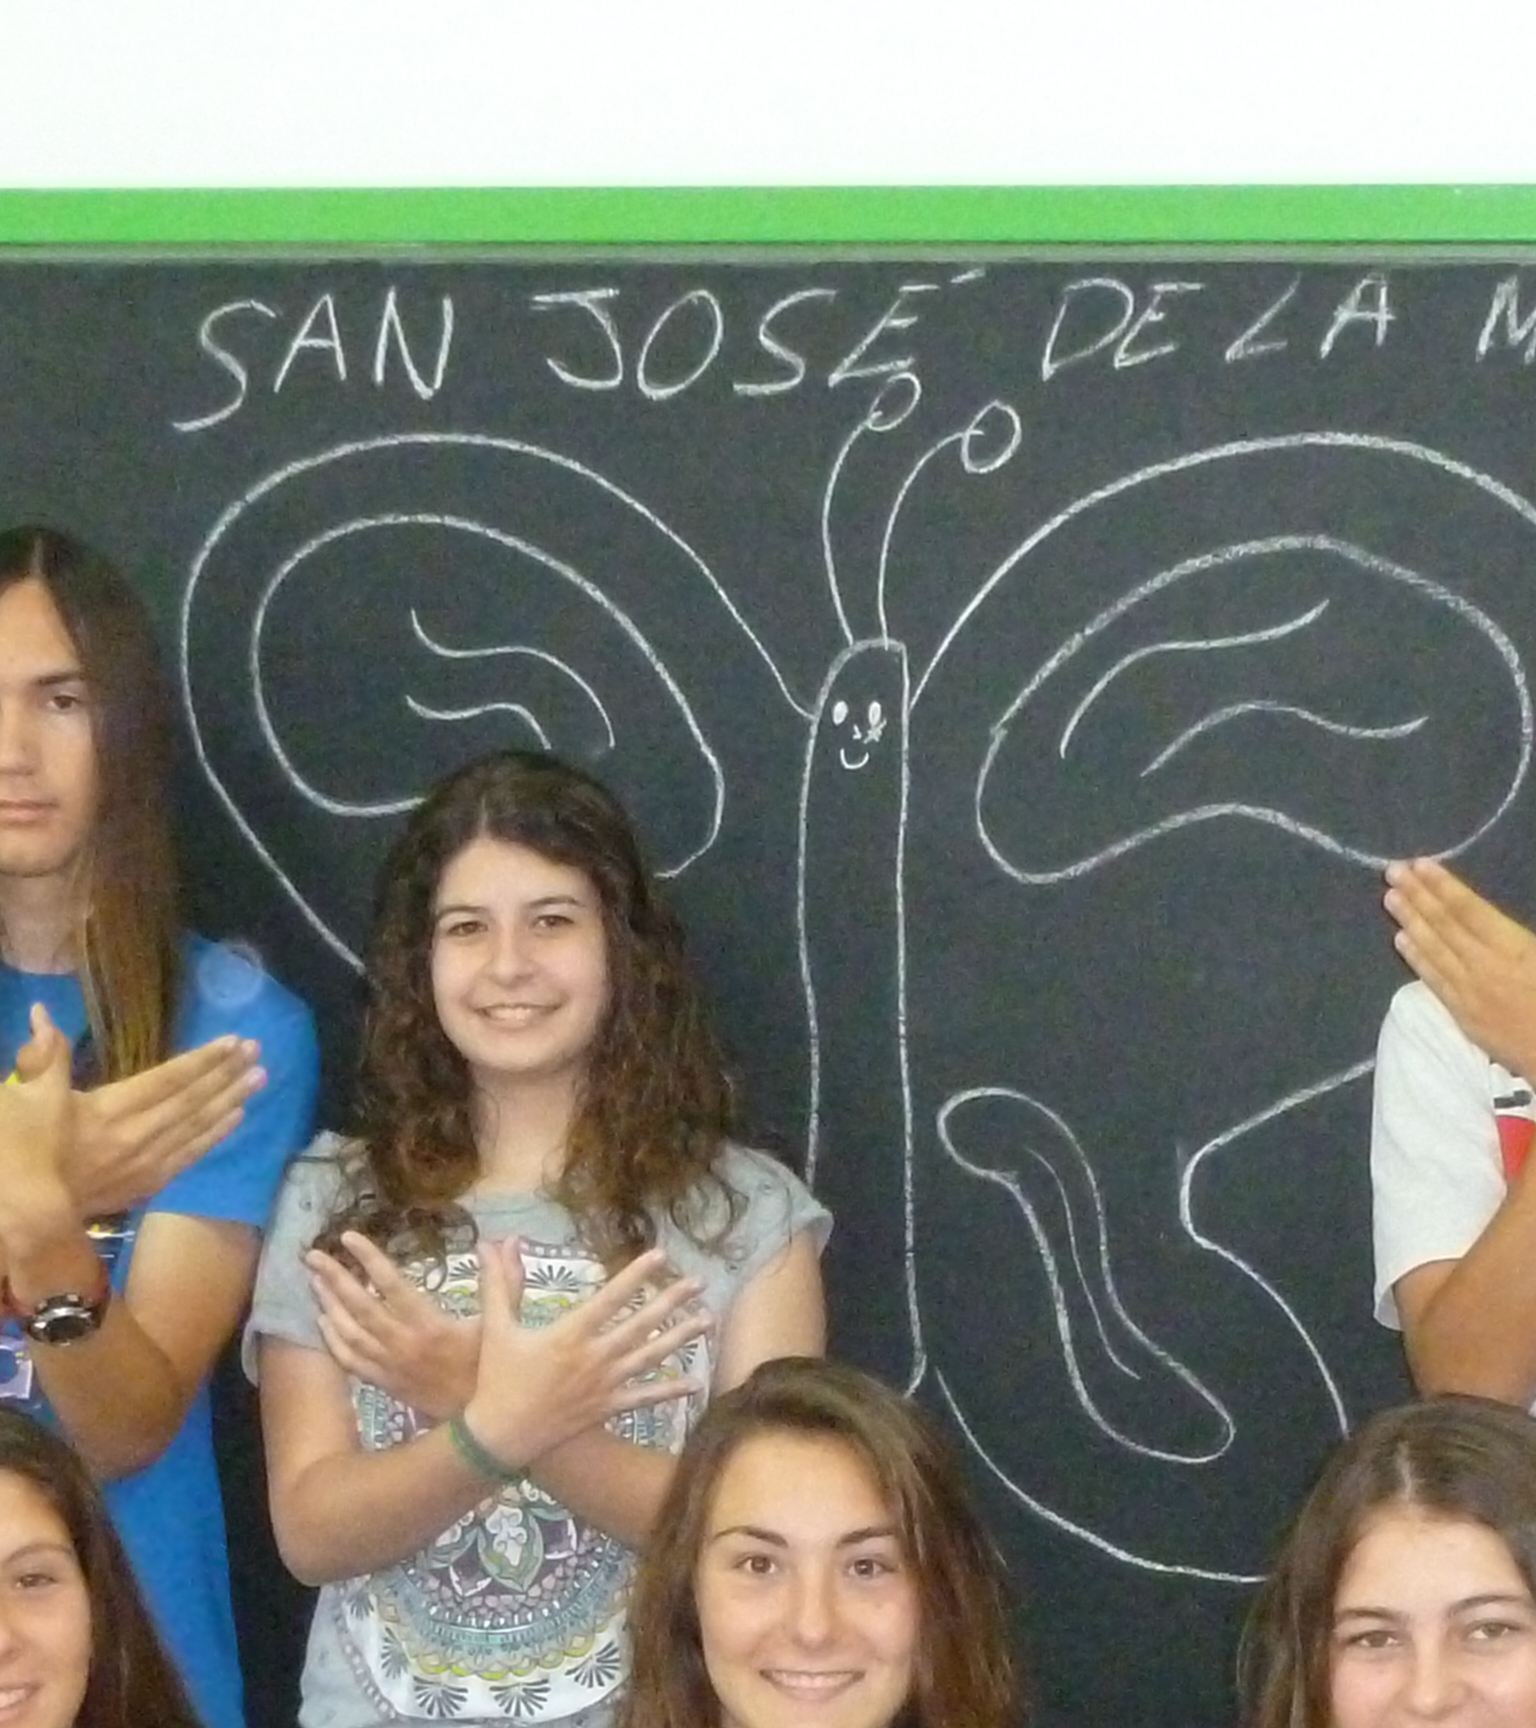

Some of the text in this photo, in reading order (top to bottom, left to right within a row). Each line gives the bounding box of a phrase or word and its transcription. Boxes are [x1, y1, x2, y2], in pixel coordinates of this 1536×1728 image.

[171, 285, 455, 433] SAN
[1039, 276, 1204, 382] DE
[1223, 270, 1399, 363] LA
